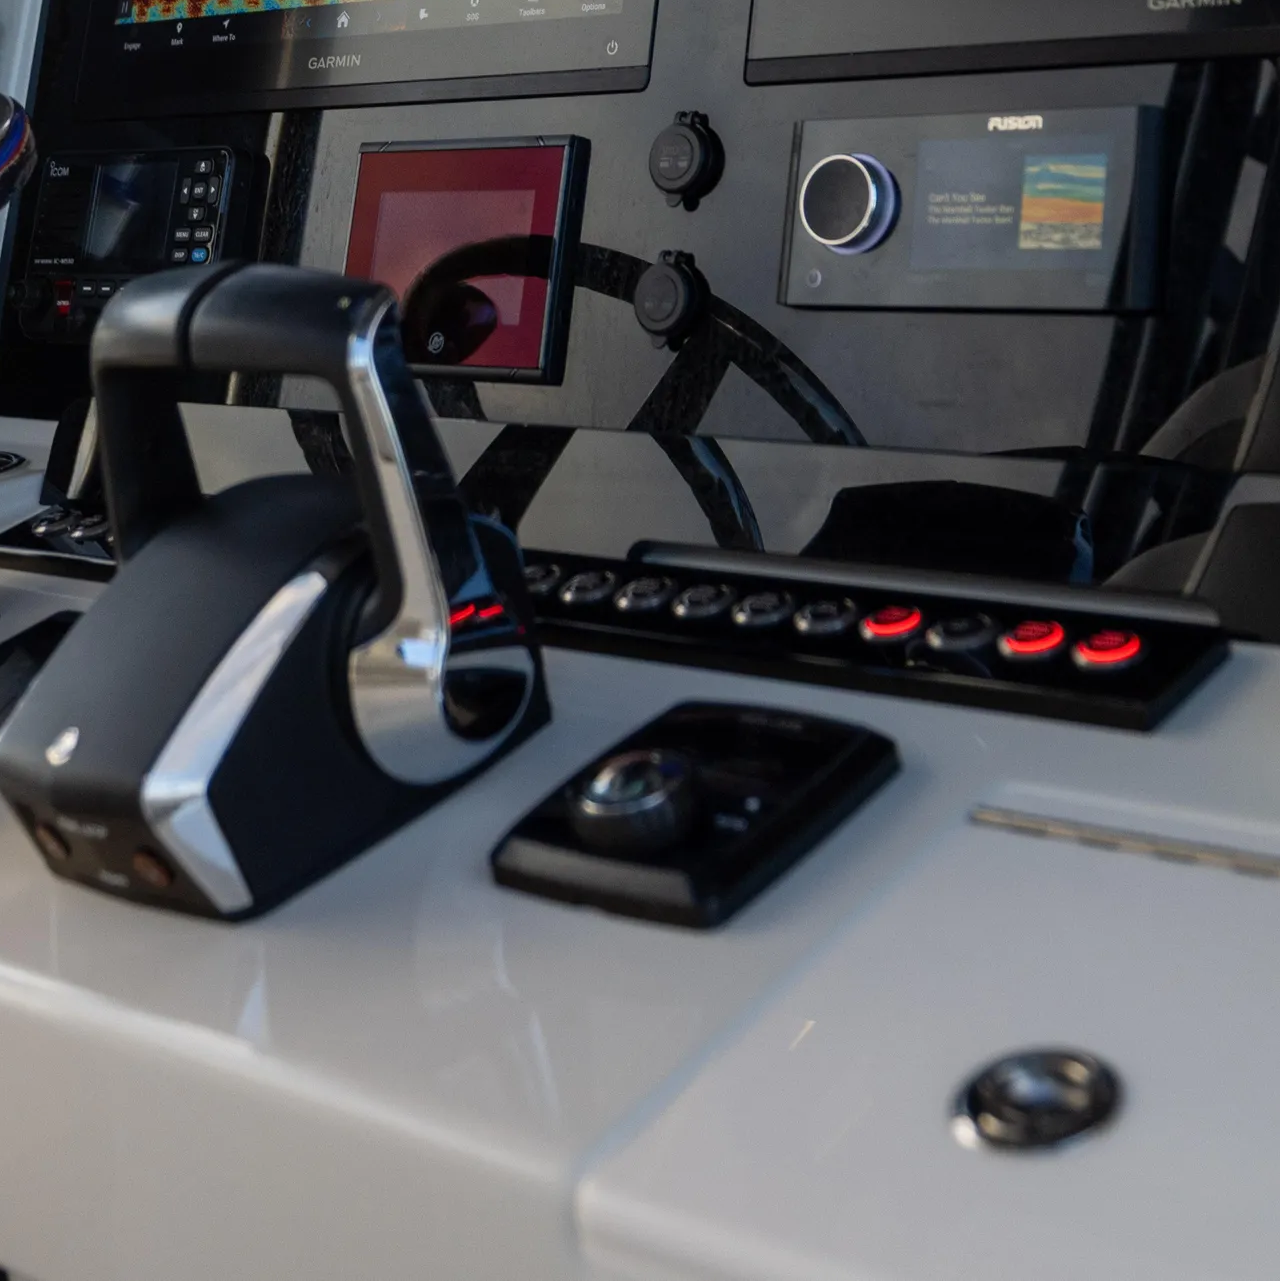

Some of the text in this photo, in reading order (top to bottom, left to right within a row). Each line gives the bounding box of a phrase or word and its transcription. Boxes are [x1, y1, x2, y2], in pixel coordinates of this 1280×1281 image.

[519, 7, 546, 17] Toolbars
[581, 2, 606, 13] Options
[308, 54, 362, 70] GARMIN
[987, 114, 1044, 132] FUSION
[195, 230, 209, 238] CLEAR
